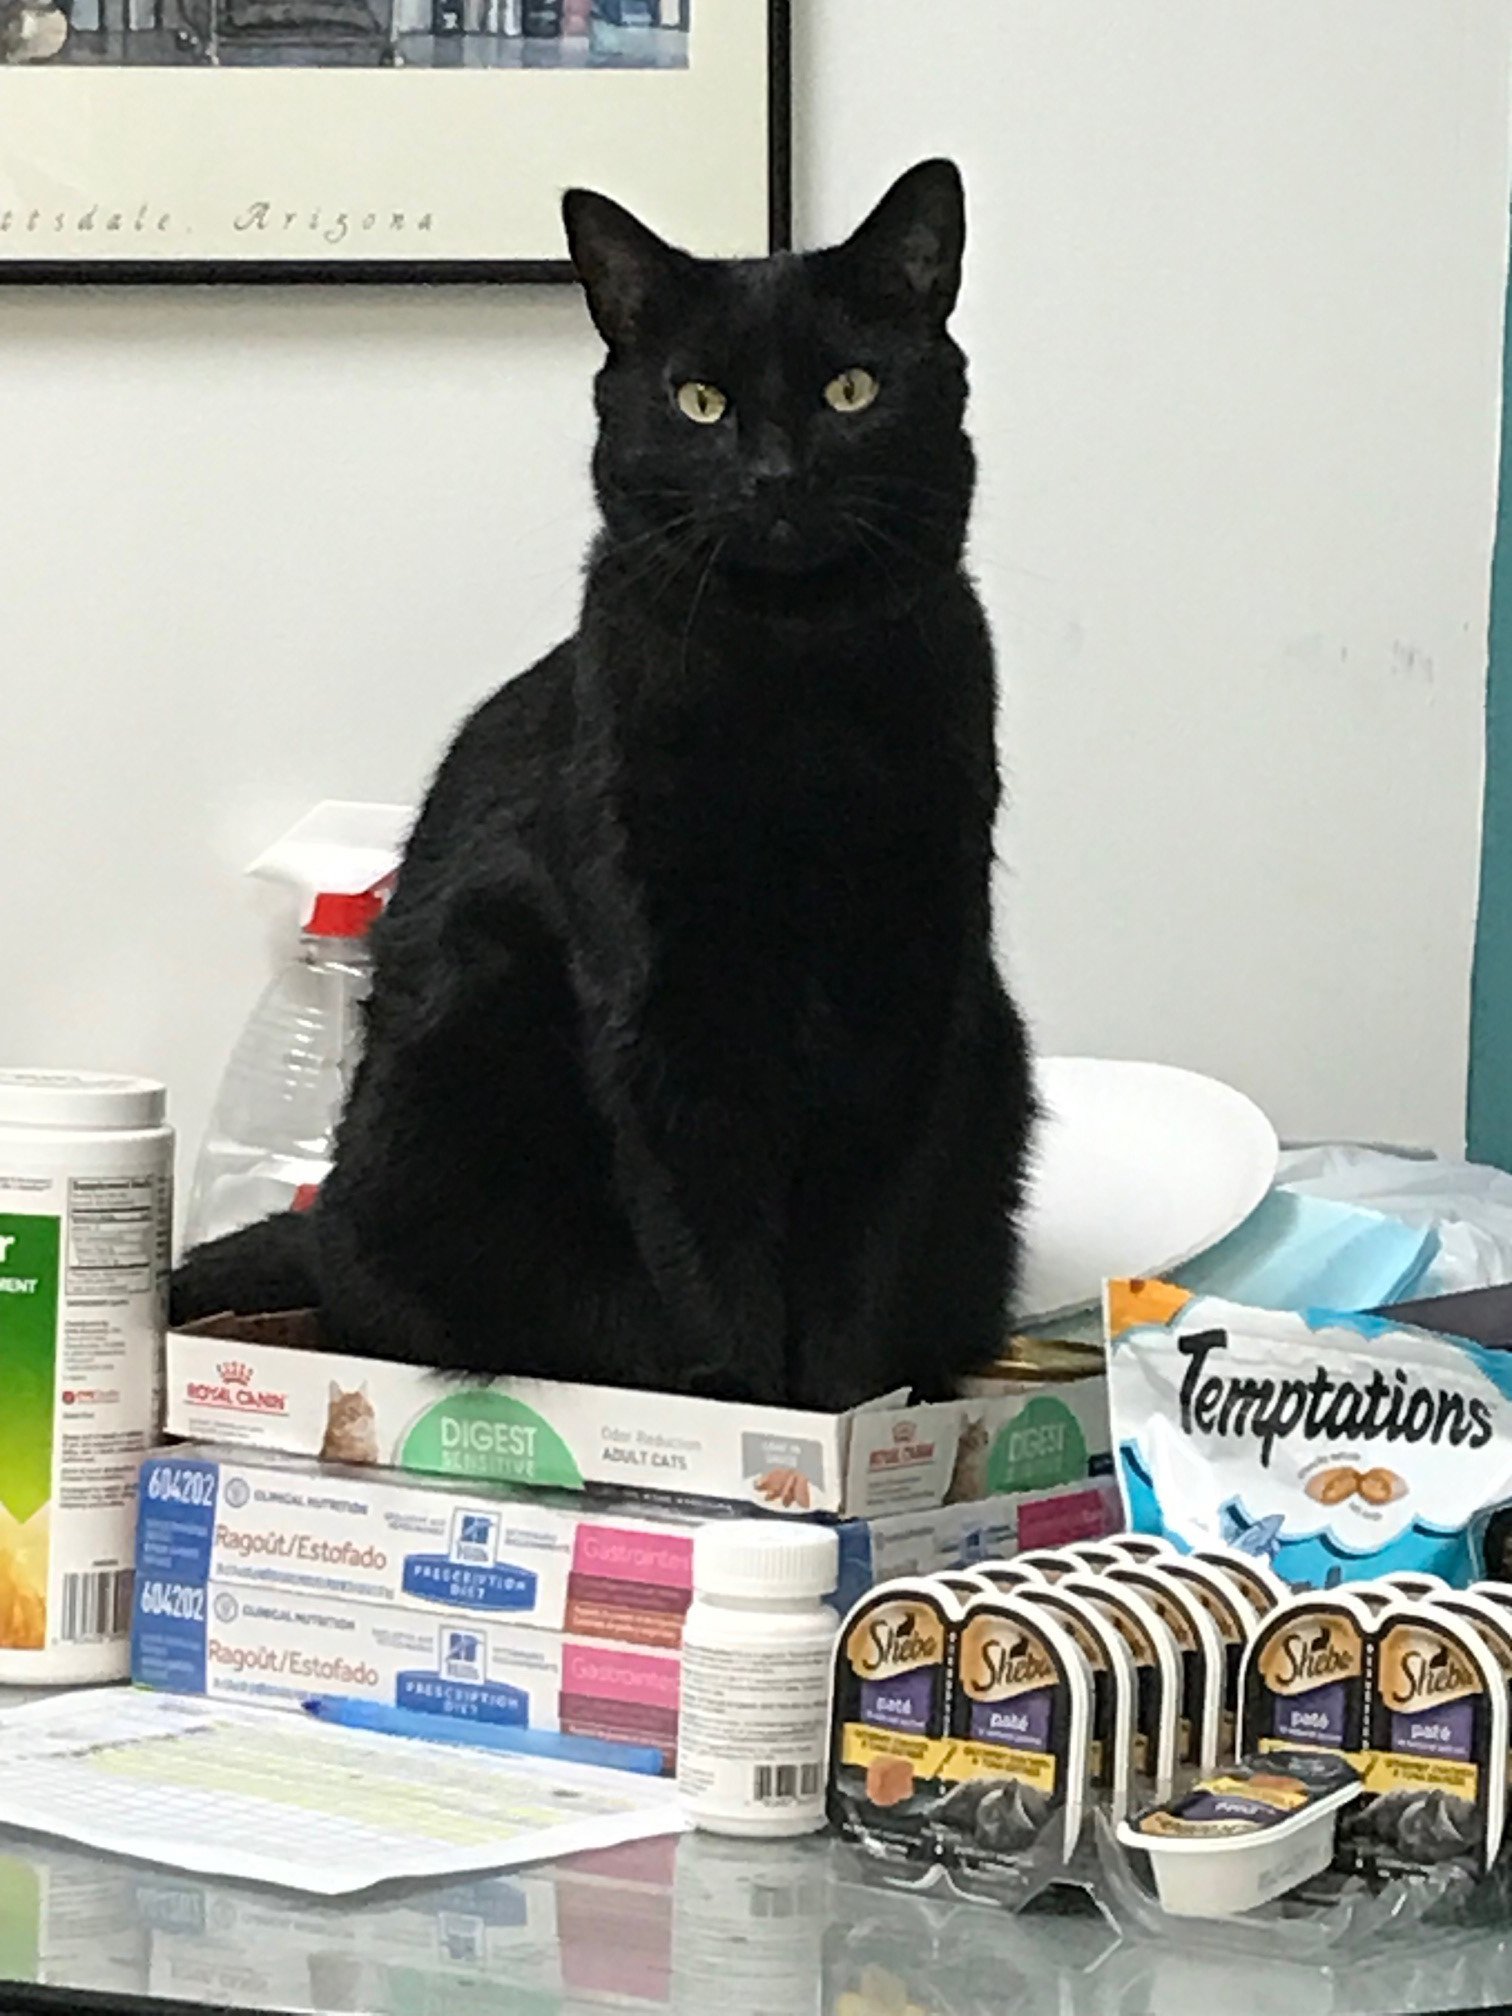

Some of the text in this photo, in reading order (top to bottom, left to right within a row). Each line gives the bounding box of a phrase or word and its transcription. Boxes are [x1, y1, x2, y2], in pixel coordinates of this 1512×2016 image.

[233, 201, 432, 243] Arizona
[186, 1382, 286, 1410] ROYAL CANIN
[1178, 1328, 1494, 1469] Temptations
[441, 1416, 538, 1458] DIGEST
[602, 1446, 688, 1471] ADULT CATS
[148, 1467, 215, 1506] 604202
[141, 1580, 205, 1621] 604202
[861, 1618, 937, 1671] Sheba
